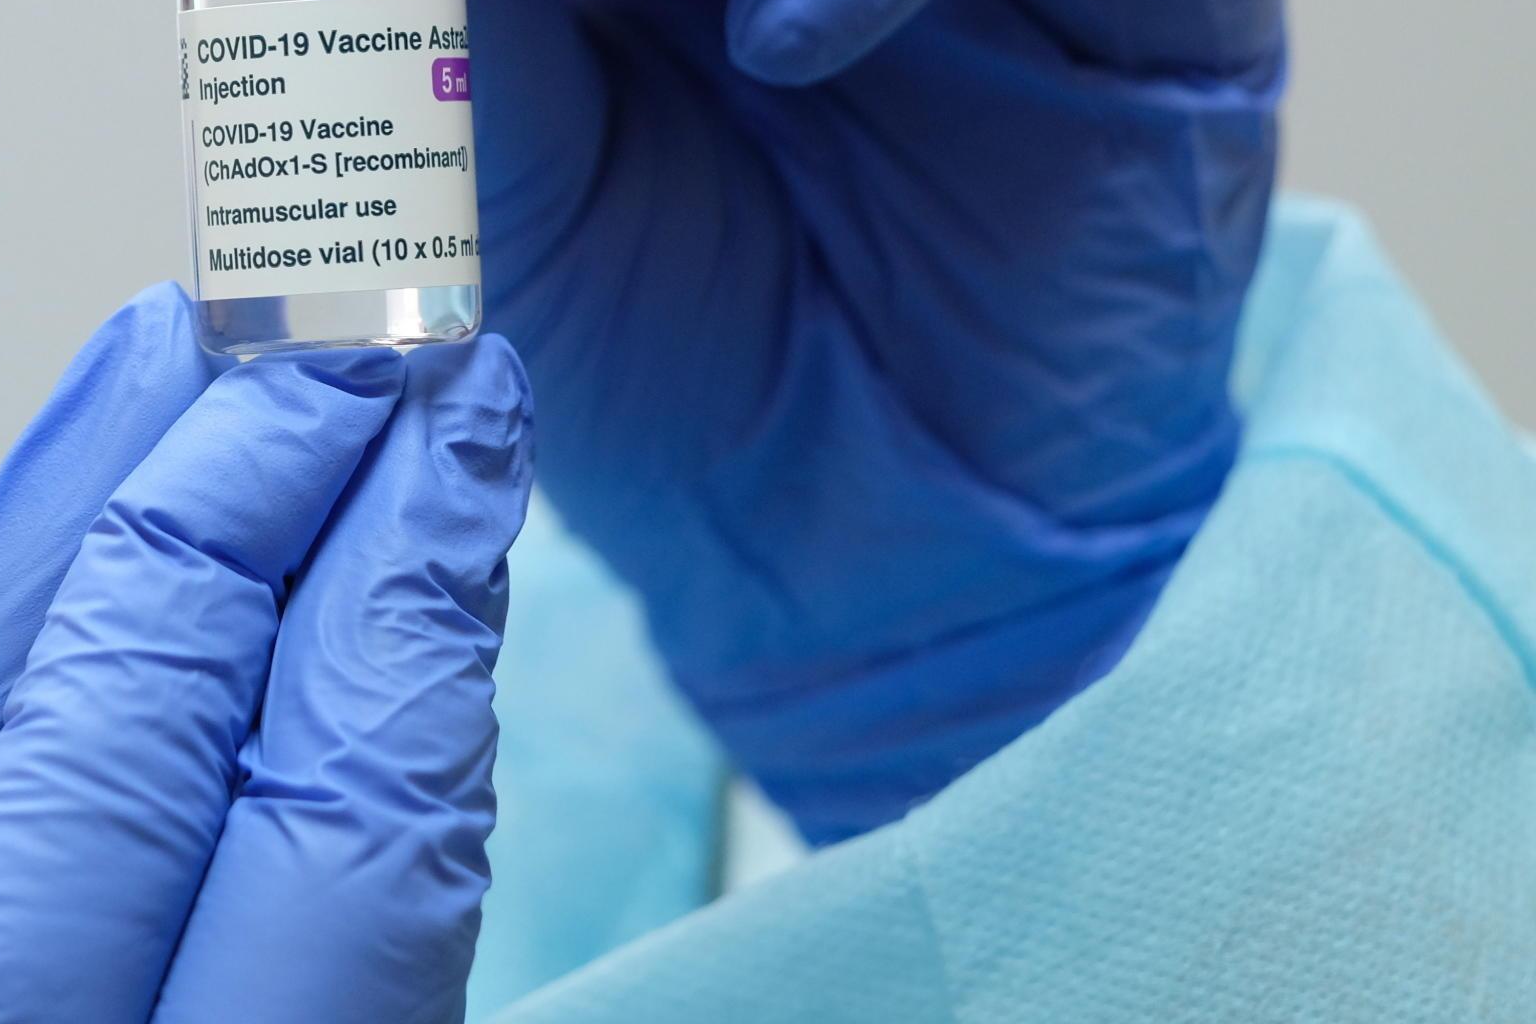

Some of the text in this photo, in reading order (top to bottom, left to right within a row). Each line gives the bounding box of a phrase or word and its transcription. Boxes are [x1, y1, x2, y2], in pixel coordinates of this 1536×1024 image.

[198, 24, 469, 63] COVID-19 Vaccine Astra
[200, 74, 285, 105] Injection
[441, 66, 468, 94] 5 ml
[203, 116, 393, 147] COVID-19 Vaccine
[205, 153, 327, 186] (ChAdOx1-S
[207, 199, 396, 226] Intramuscular use
[210, 246, 311, 271] Multidose
[319, 240, 363, 264] vial
[372, 238, 407, 266] (10
[414, 242, 427, 259] x
[433, 236, 457, 258] 0.5
[460, 233, 473, 257] ml
